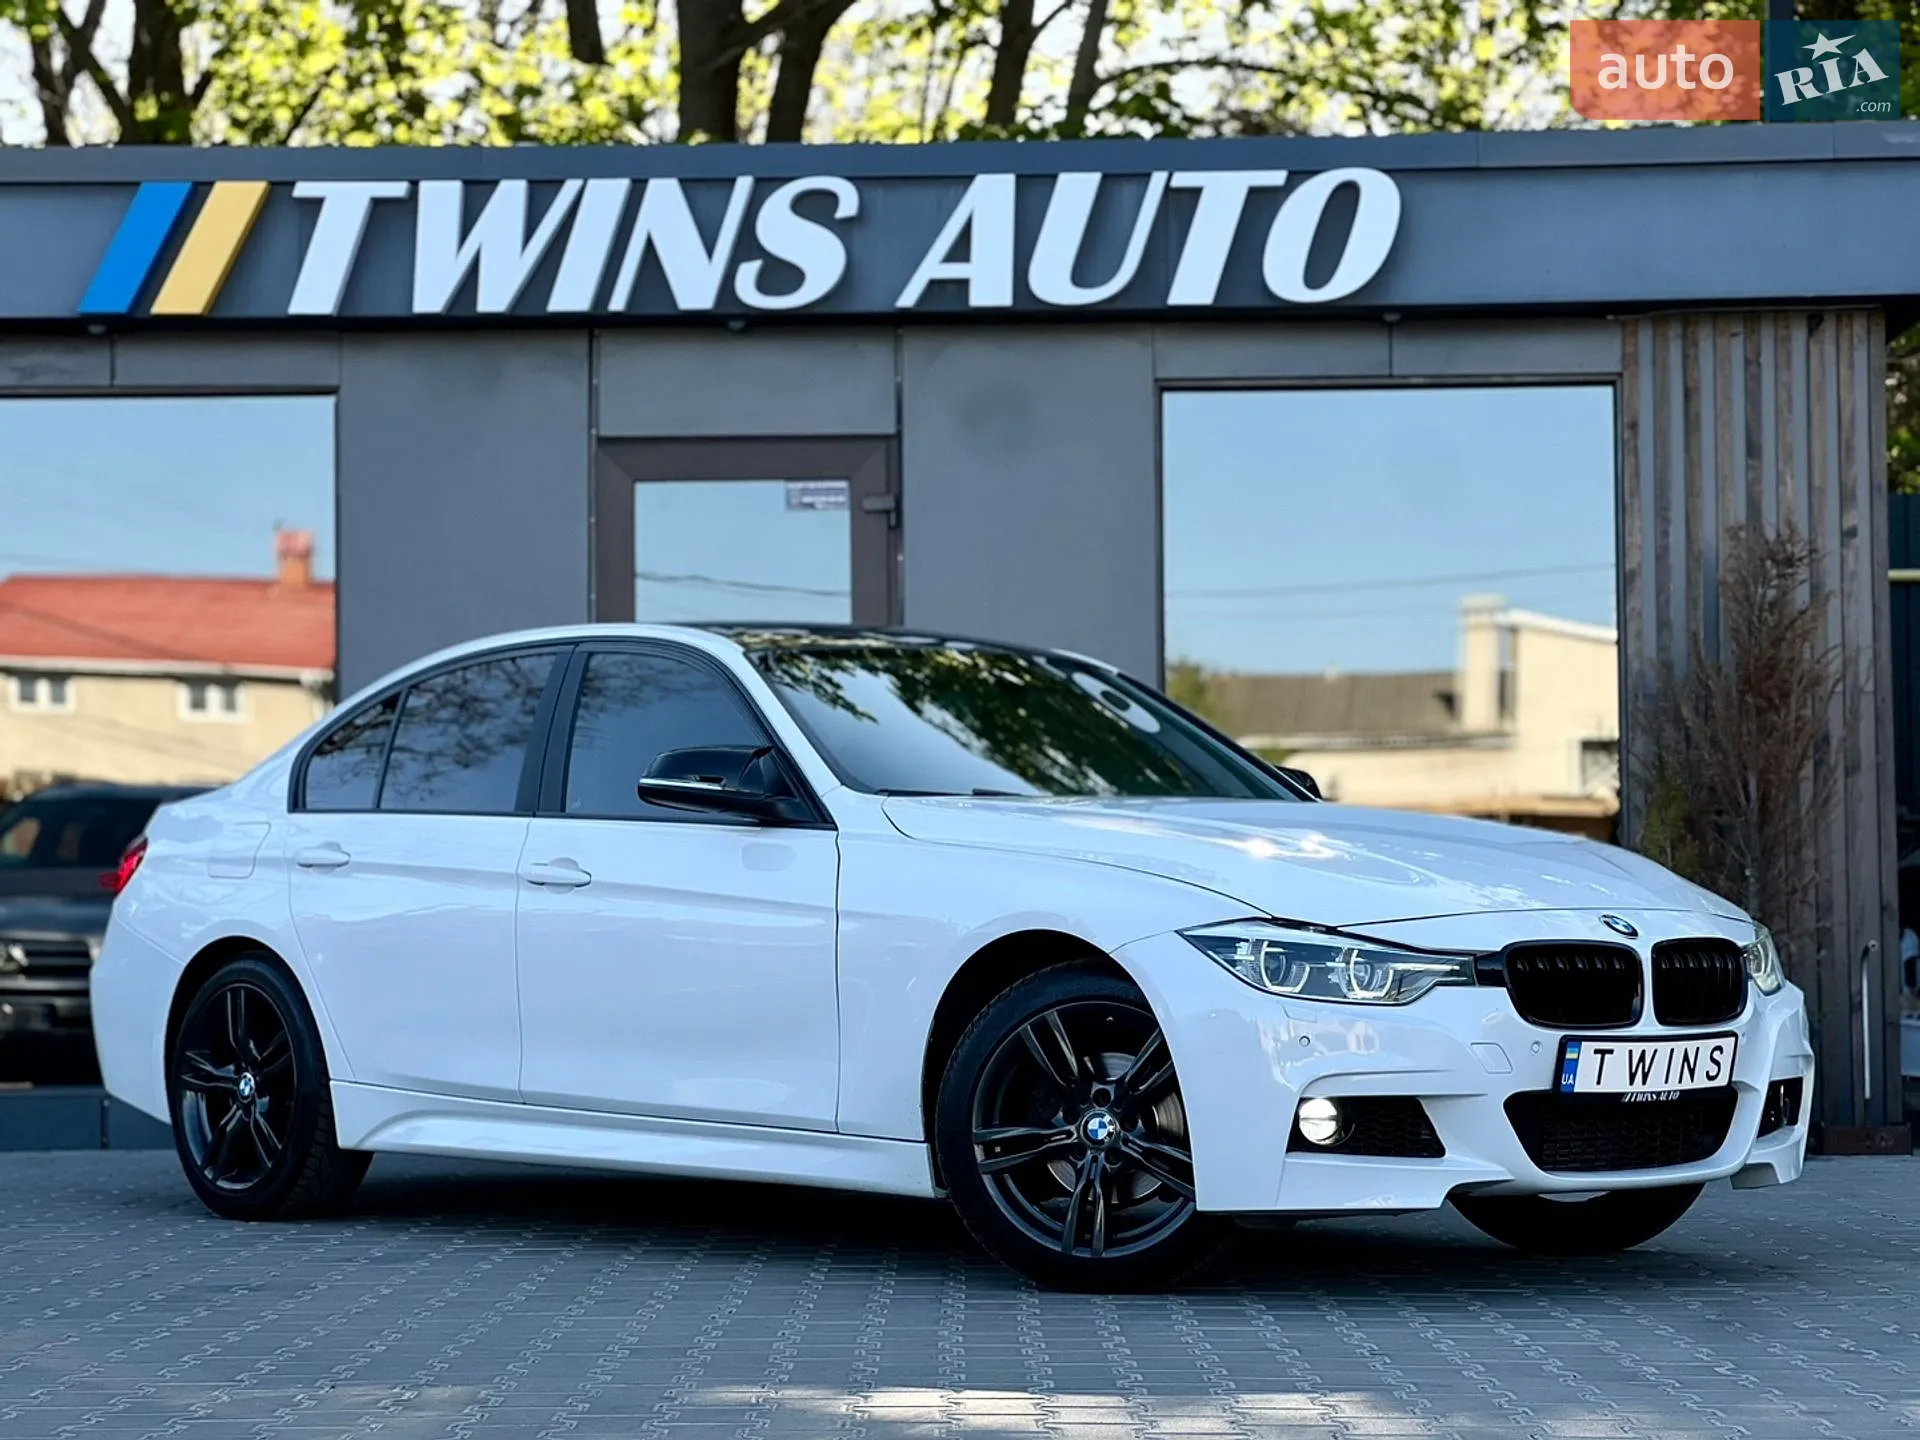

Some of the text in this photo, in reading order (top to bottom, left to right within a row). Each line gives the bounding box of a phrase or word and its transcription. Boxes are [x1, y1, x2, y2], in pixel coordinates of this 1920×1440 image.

[286, 166, 1402, 316] TWINS AUTO
[1561, 1073, 1575, 1085] UA
